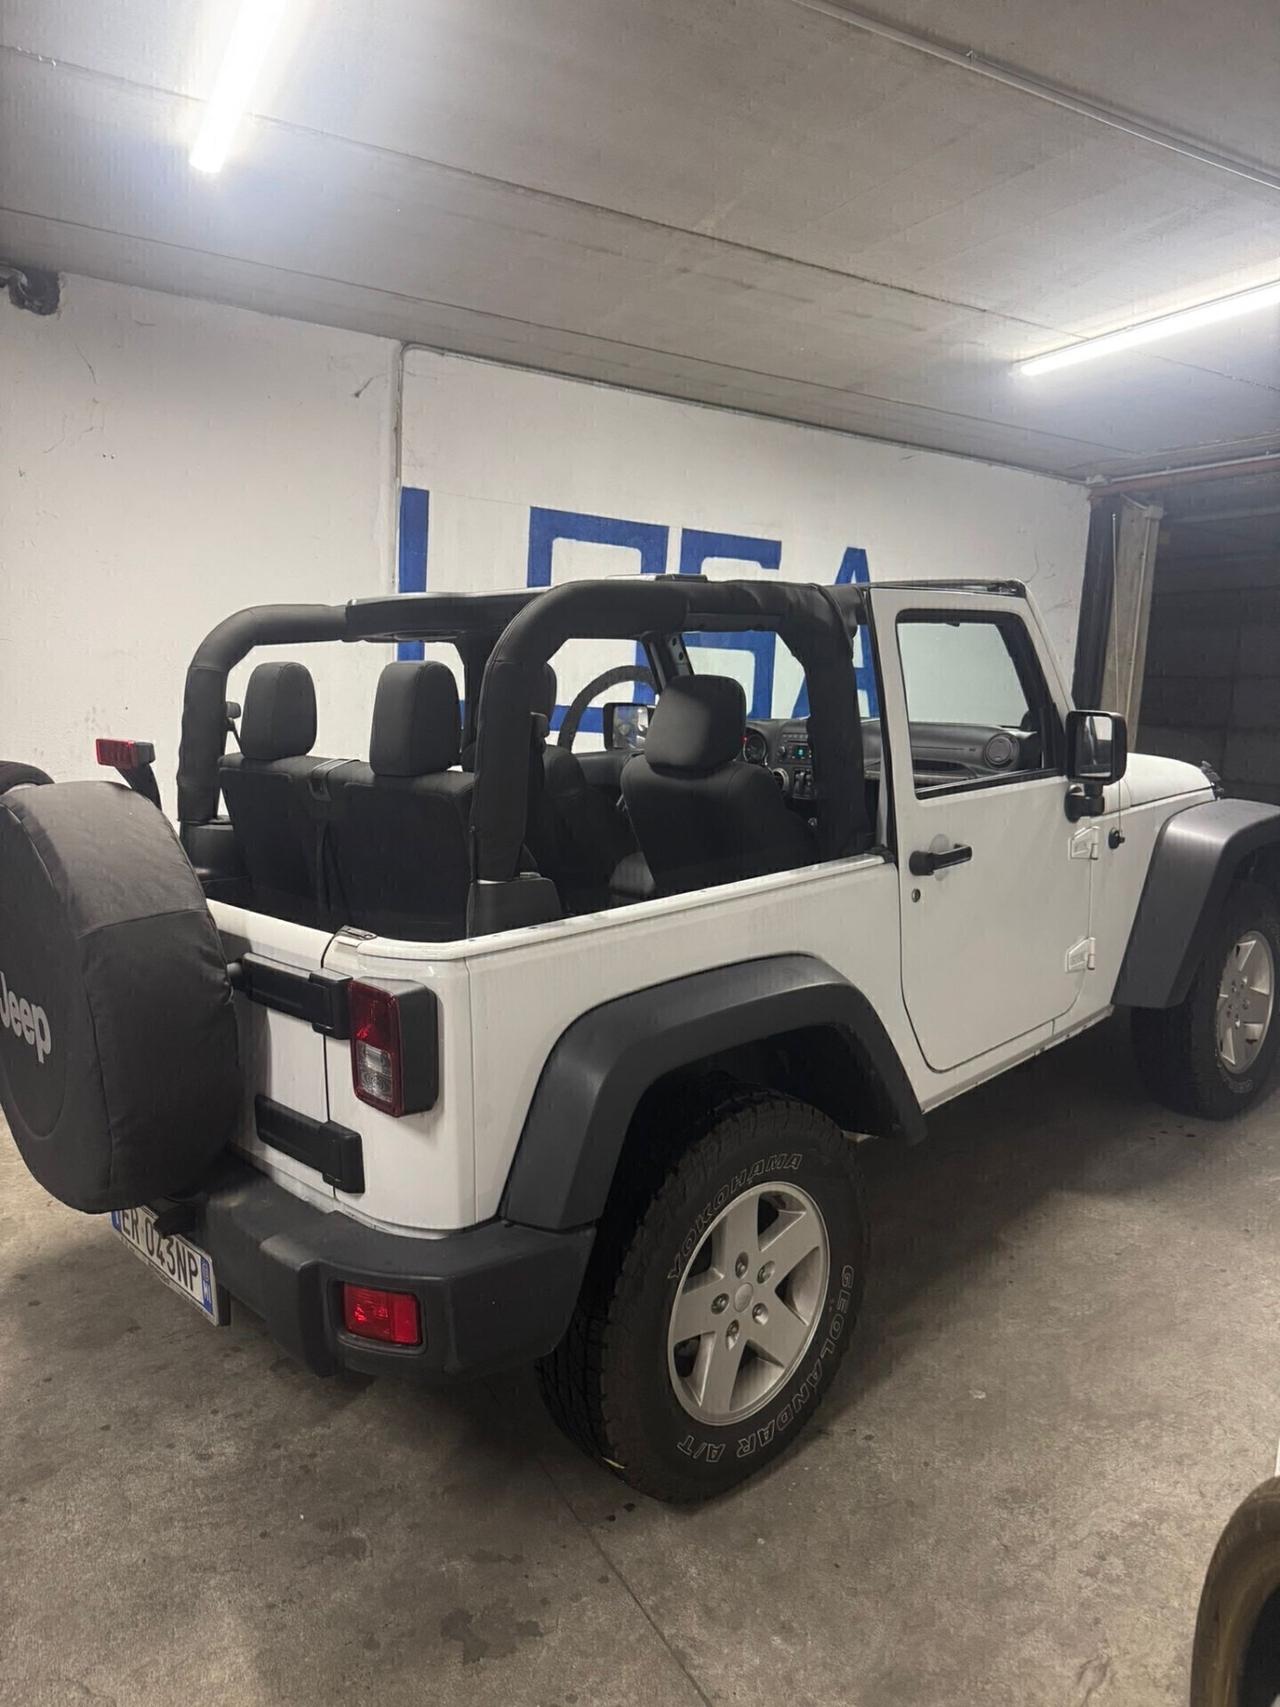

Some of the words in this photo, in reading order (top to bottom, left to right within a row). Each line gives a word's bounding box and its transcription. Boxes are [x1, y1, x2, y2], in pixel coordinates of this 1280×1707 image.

[0, 970, 52, 1065] Jeep
[667, 1152, 804, 1281] YOKOHAMA
[736, 1264, 855, 1459] GEOLANDAR
[676, 1434, 726, 1463] A/T
